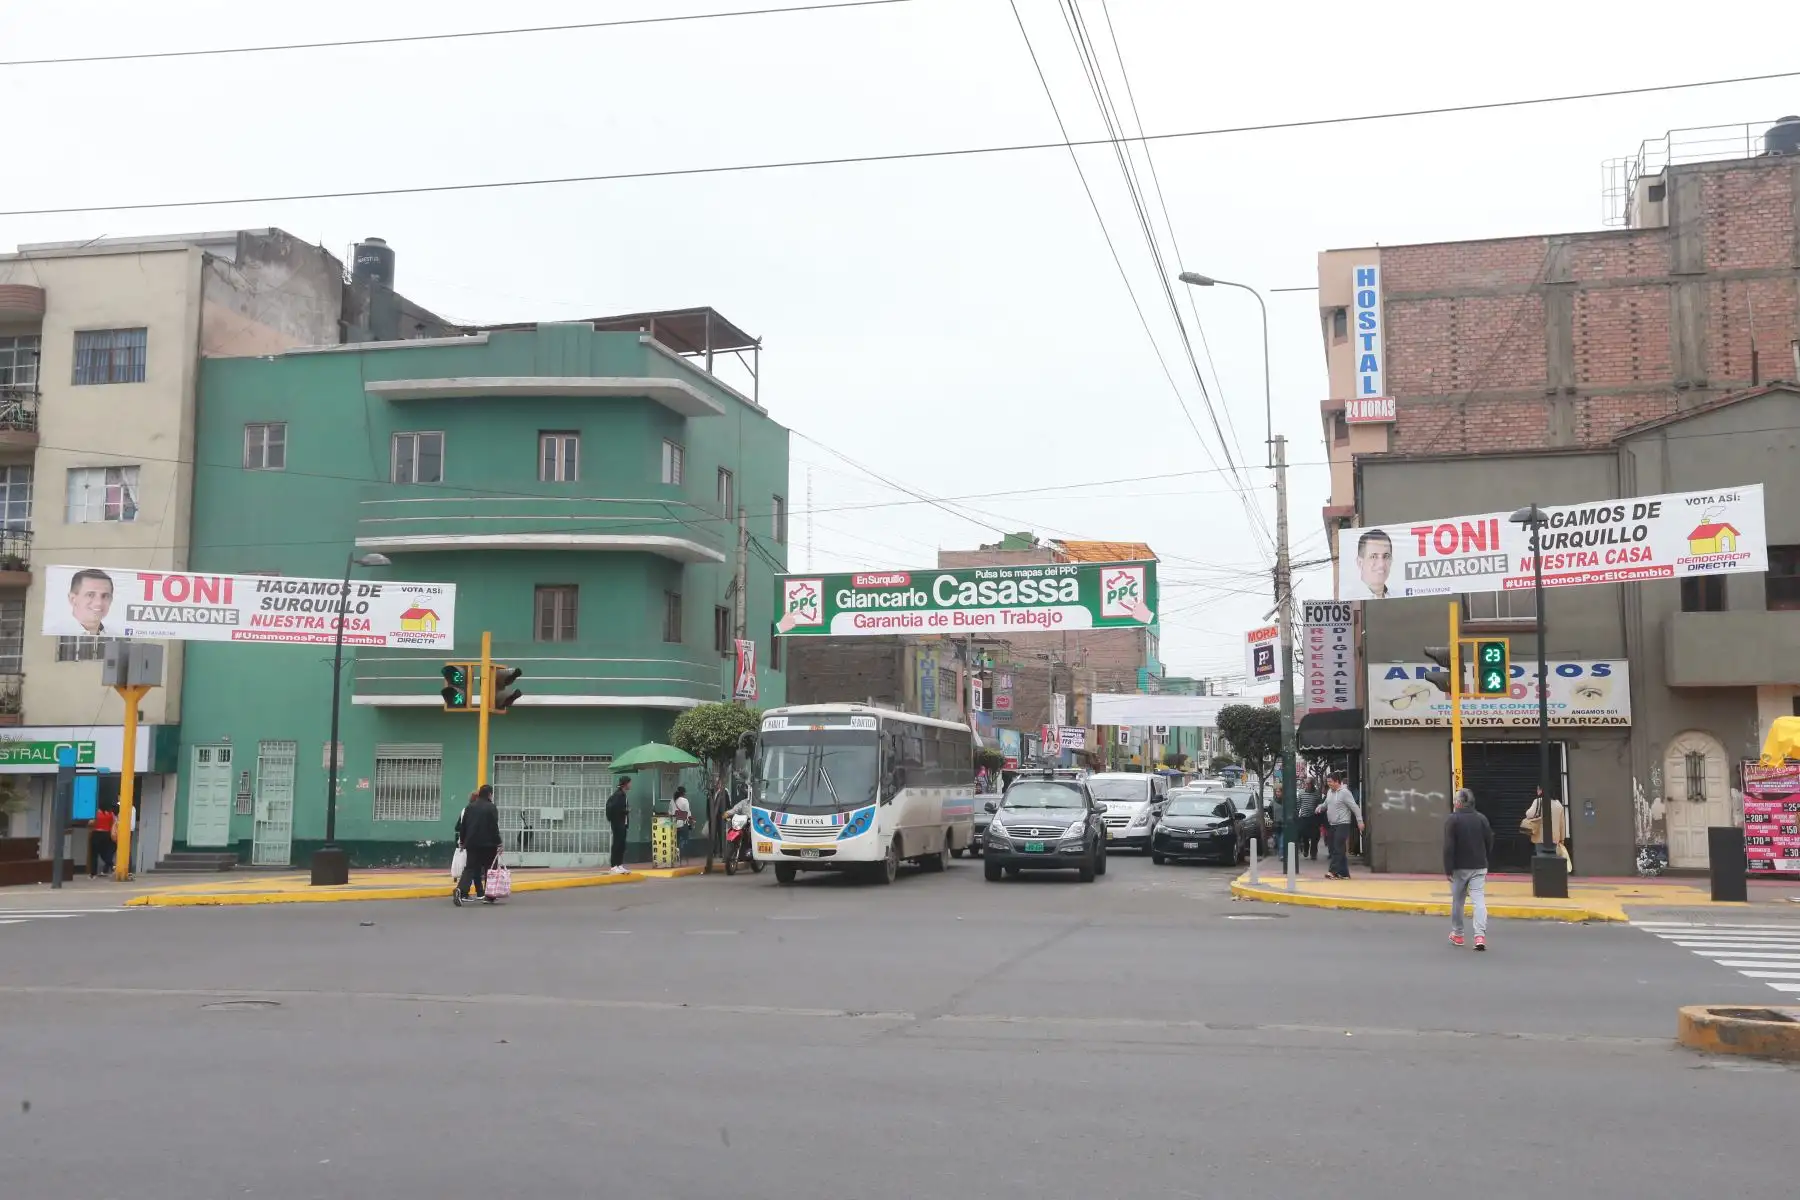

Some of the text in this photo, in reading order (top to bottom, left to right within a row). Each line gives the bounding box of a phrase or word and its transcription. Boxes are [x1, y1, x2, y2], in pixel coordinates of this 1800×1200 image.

[1357, 268, 1379, 394] HOSTAL
[1346, 400, 1395, 418] 24 HORAS
[1685, 496, 1716, 506] VOTA
[1632, 501, 1662, 521] DE
[1410, 518, 1500, 557] TONI
[1604, 545, 1653, 565] CASA
[1676, 551, 1751, 565] DEMOCRACIA
[975, 566, 1078, 580] Pulsa los mapas del PPC
[1407, 556, 1507, 579] TAVARONE
[1687, 561, 1737, 571] DIRECTA
[137, 572, 235, 605] TONI
[357, 584, 383, 598] DE
[835, 574, 1080, 609] Giancarlo Casassa
[1107, 582, 1138, 604] PPC
[790, 593, 817, 613] PPC
[130, 605, 238, 624] TAVARONE
[250, 614, 325, 630] NUESTRA
[853, 609, 1063, 628] Garantia de Buen Trabajo
[1305, 605, 1351, 623] FOTOS
[389, 631, 446, 640] DEMOCRACIA
[397, 637, 435, 645] DIRECTA
[1247, 626, 1279, 643] MORA
[1485, 649, 1501, 661] 23
[1310, 627, 1326, 704] REVELADOS
[1332, 627, 1348, 703] DIGITALES
[1373, 718, 1420, 726] MEDIDA
[1425, 718, 1441, 726] DE
[1467, 717, 1505, 725] VISTA
